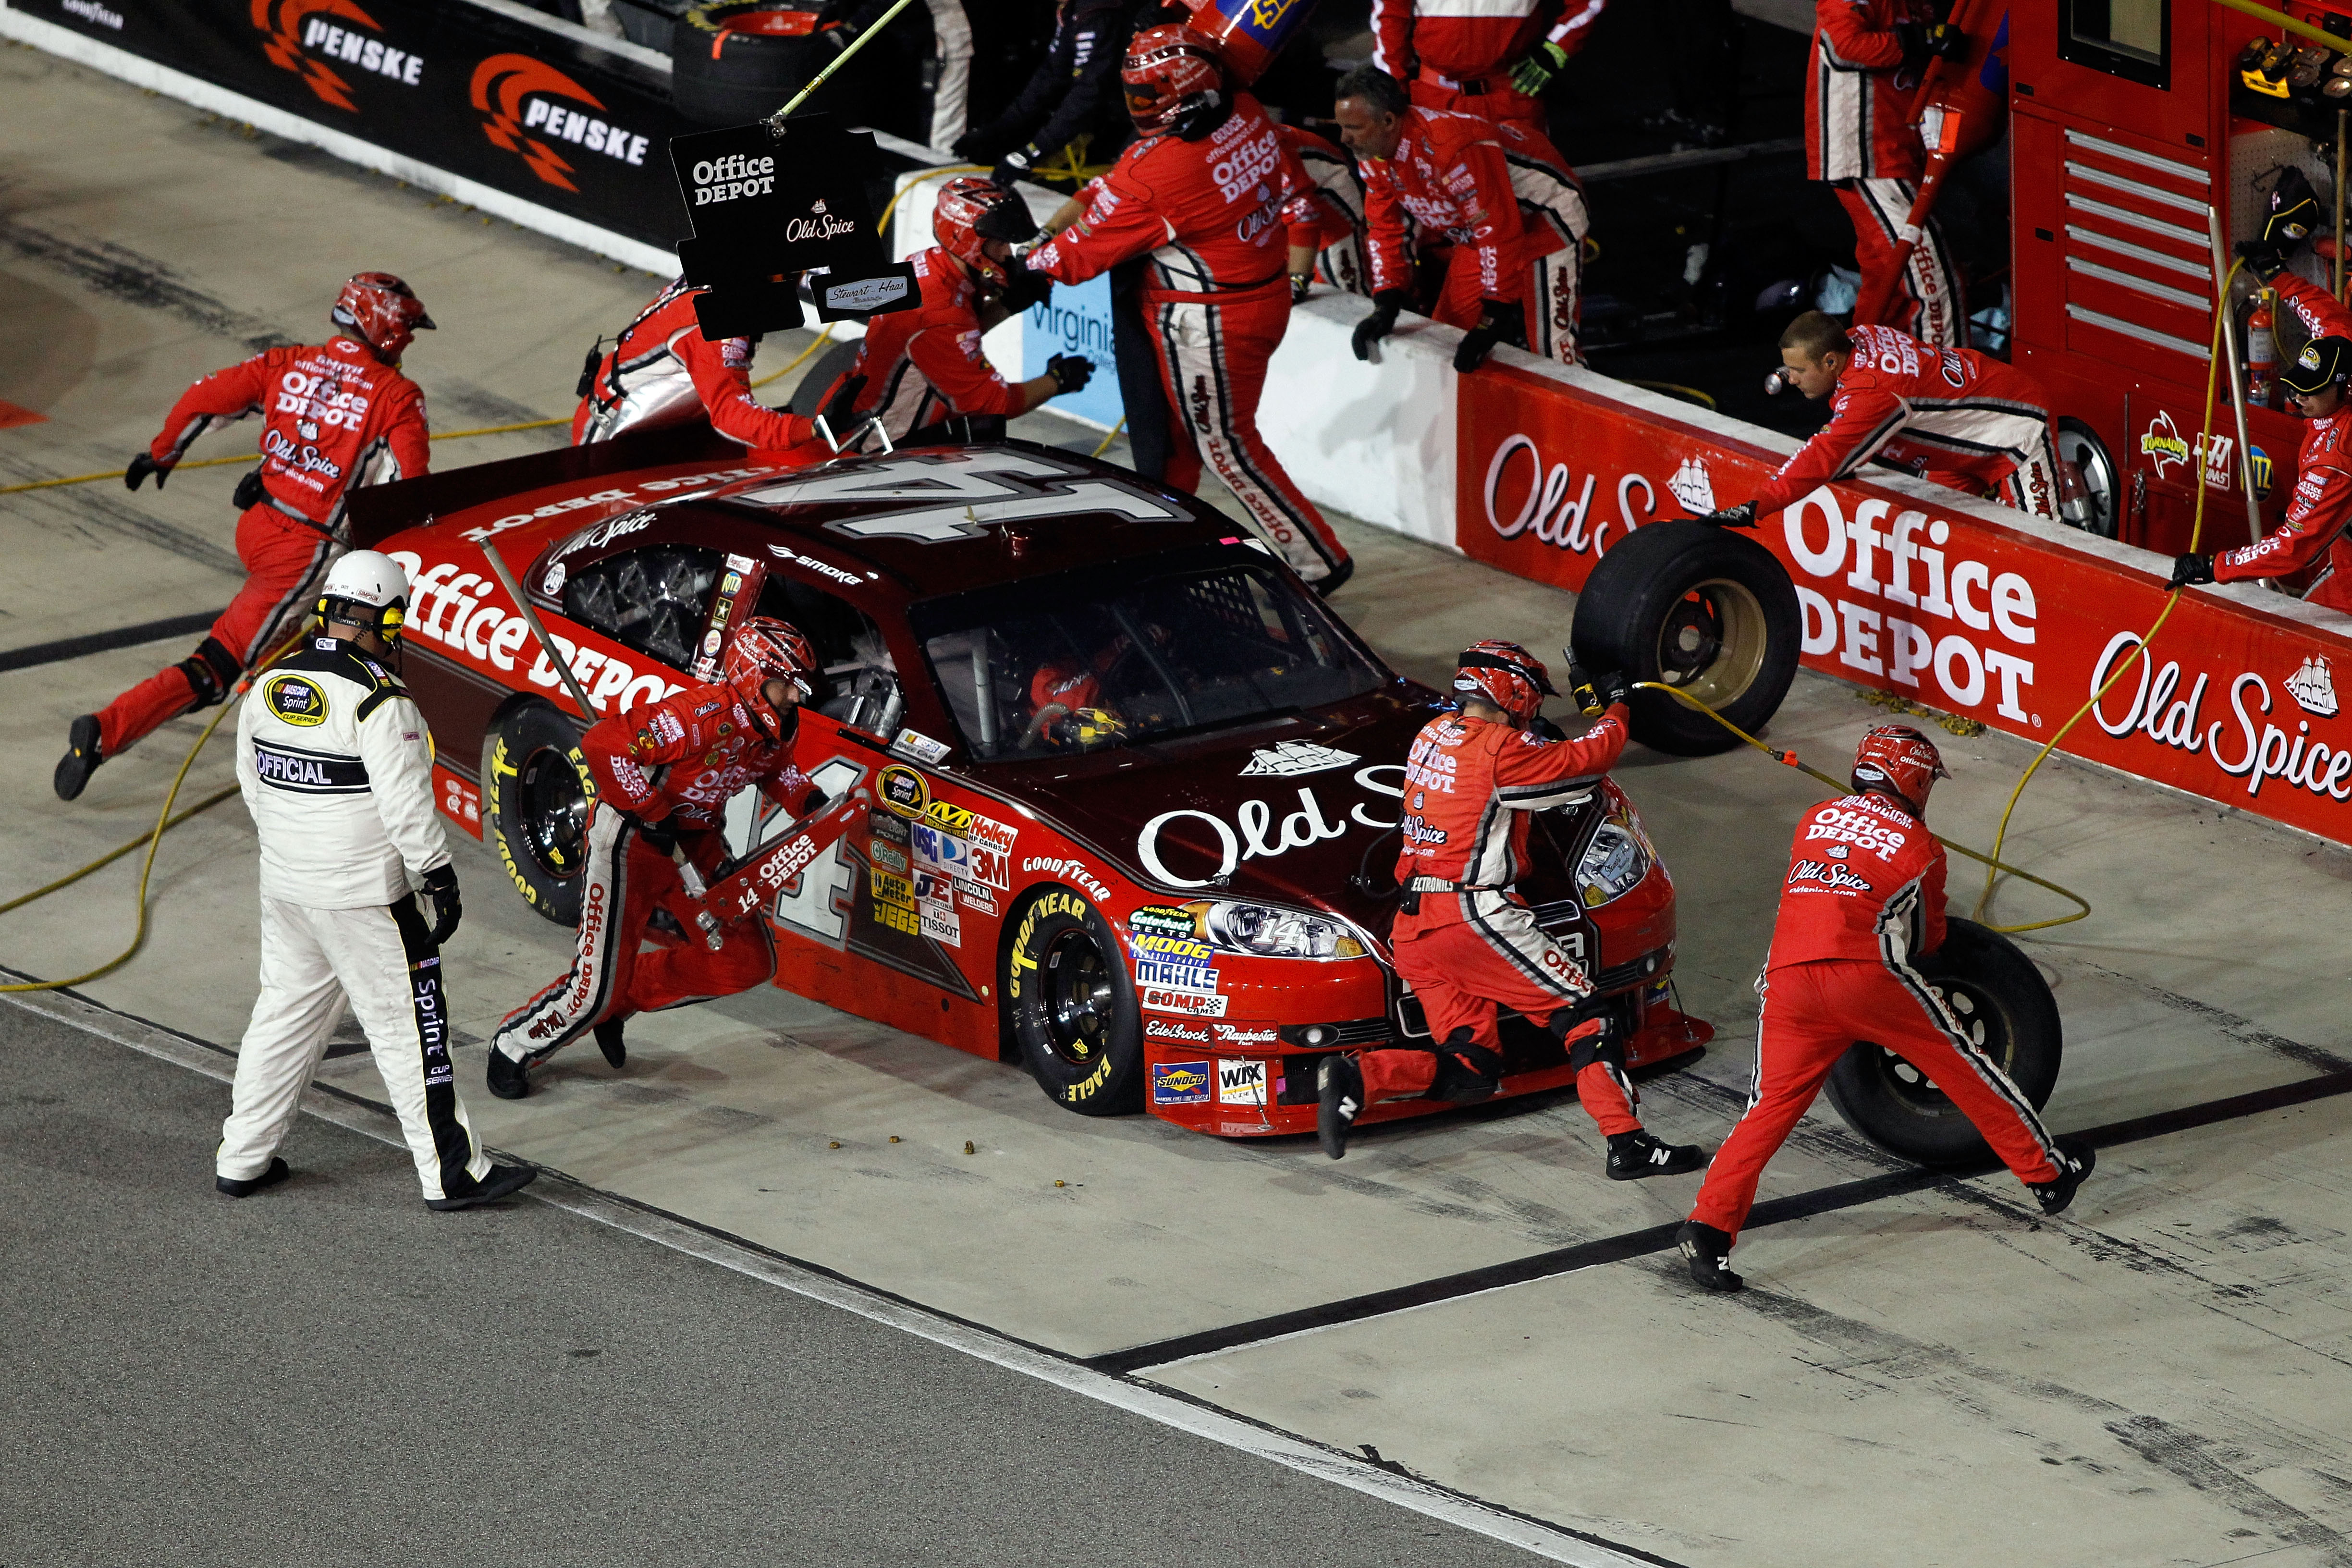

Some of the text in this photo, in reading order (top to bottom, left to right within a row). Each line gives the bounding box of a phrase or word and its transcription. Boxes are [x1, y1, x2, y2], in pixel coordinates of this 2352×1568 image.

[306, 18, 424, 86] PENSKE
[525, 98, 649, 166] PENSKE
[693, 154, 774, 185] Office
[1213, 130, 1276, 185] Office
[1219, 144, 1281, 204] DEPOT
[695, 176, 775, 206] DEPOT
[786, 214, 855, 242] Old Spice
[829, 281, 904, 300] Stewart Haas
[1928, 298, 1946, 348] DEPO
[276, 391, 363, 432] DEPOT
[266, 429, 341, 479] Old Spice
[2143, 435, 2187, 457] TORNADOS
[1207, 438, 1247, 492] DEPOT
[1484, 433, 1590, 553] Old
[458, 488, 636, 543] DEPOT
[589, 510, 656, 549] Spice
[1244, 493, 1292, 544] Office
[1782, 484, 2037, 645] Office
[2234, 541, 2281, 566] DEPOT
[722, 573, 742, 593] RITZ
[796, 555, 863, 586] SMOKE
[357, 589, 380, 602] SIMPSON
[1794, 584, 2034, 724] DEPOT
[283, 684, 310, 697] NASCAR
[283, 695, 308, 710] Sprint
[295, 715, 319, 724] SERIES
[649, 719, 661, 734] Old
[695, 708, 708, 717] Old
[2089, 630, 2352, 799] Old Spice
[657, 712, 674, 744] DEPOT
[916, 749, 935, 761] CAR
[1409, 738, 1458, 774] Office
[1900, 756, 1920, 767] Office
[1910, 746, 1922, 756] Old
[257, 750, 332, 785] OFFICIAL
[569, 746, 594, 807] EAGL
[610, 755, 641, 798] DEPOT
[1406, 760, 1456, 794] DEPOT
[891, 785, 912, 801] Sprint
[490, 735, 537, 905] GOODYEAR
[1403, 814, 1447, 845] ld Spice
[1814, 808, 1906, 848] Office
[876, 829, 904, 842] POLE
[913, 823, 939, 863] USG
[968, 833, 1003, 852] HP CARBS
[970, 817, 1014, 854] Holley
[1137, 786, 1346, 888] Old
[1805, 824, 1897, 861] DEPOT
[759, 834, 811, 879] Office
[768, 842, 817, 889] DEPOT
[943, 861, 968, 877] DIRECTV
[972, 847, 1009, 891] 3M
[914, 873, 950, 903] JE
[954, 877, 990, 900] LINCOLN
[1023, 856, 1112, 903] GOODYEAR
[1788, 859, 1871, 891] Old Spice
[738, 887, 760, 914] 14
[882, 885, 912, 905] Meter
[926, 896, 953, 911] PISTONS
[962, 893, 994, 913] WELDERS
[581, 882, 605, 958] Office
[875, 903, 920, 936] JEGS
[920, 915, 959, 938] TISSOT
[1130, 911, 1194, 932] Gatorback
[1142, 906, 1190, 919] GOODYEAR
[1010, 892, 1087, 999] GOODYEAR
[1131, 923, 1187, 939] BELTS
[1252, 917, 1306, 947] 14
[1133, 933, 1214, 960] MOOG
[1133, 951, 1205, 968] CHASSIS PARTS
[419, 956, 440, 968] NASCAR
[1138, 960, 1218, 989] MAHLE
[569, 962, 593, 1017] DEPOT
[1148, 990, 1206, 1009] COMP
[415, 978, 444, 1056] Sprint
[548, 1010, 567, 1032] Old
[1187, 1006, 1216, 1016] CAMS
[1145, 1019, 1210, 1043] Edelbrock
[425, 1074, 453, 1086] SERIES
[430, 1065, 450, 1075] CUP
[1067, 1053, 1113, 1102] EAGLE
[1158, 1074, 1206, 1088] SUNOCO
[1220, 1063, 1263, 1088] WIX
[1222, 1088, 1264, 1101] FILTES
[1649, 1148, 1671, 1165] N
